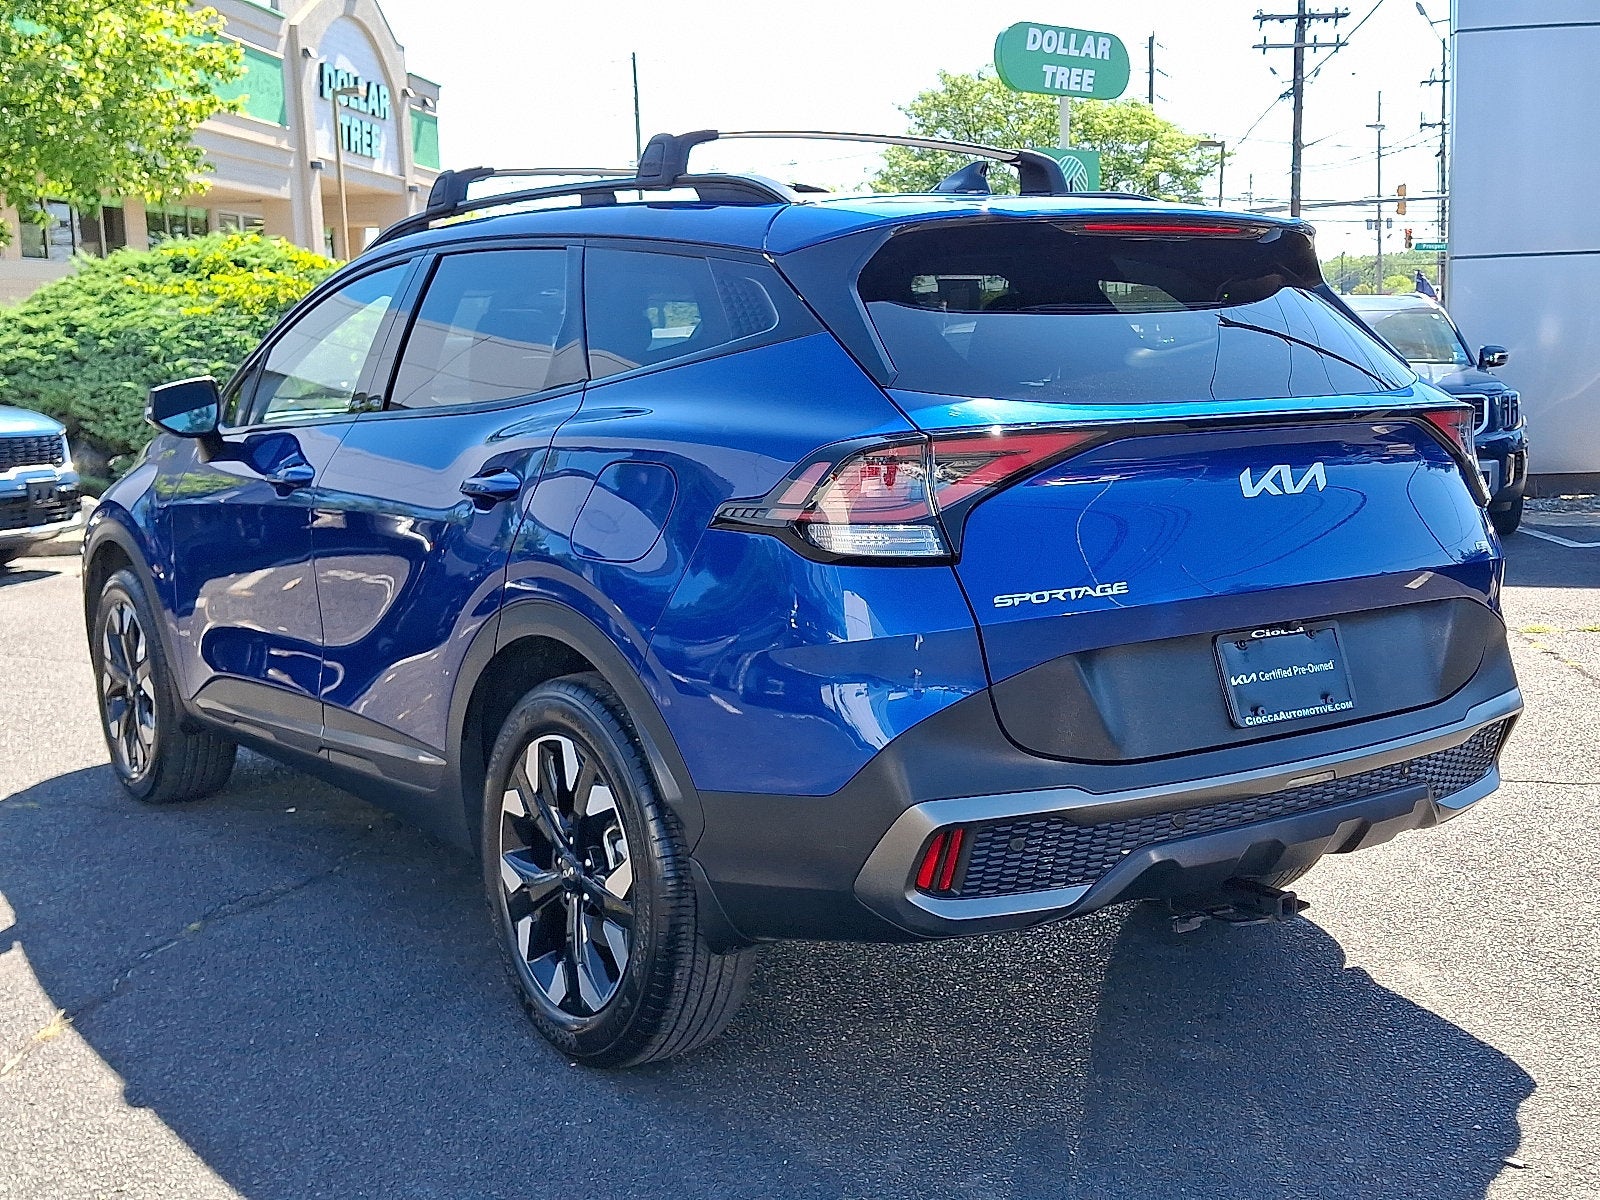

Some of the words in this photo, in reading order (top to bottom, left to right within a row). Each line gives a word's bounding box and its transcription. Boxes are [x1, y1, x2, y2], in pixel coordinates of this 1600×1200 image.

[1026, 27, 1112, 60] DOLLAR
[319, 61, 391, 120] DOLLAR
[1042, 64, 1096, 93] TREE
[340, 114, 382, 159] TREE
[1239, 461, 1328, 498] KIA
[993, 581, 1130, 608] SPORTAGE
[1230, 672, 1258, 686] KIA
[1259, 667, 1293, 681] Certified
